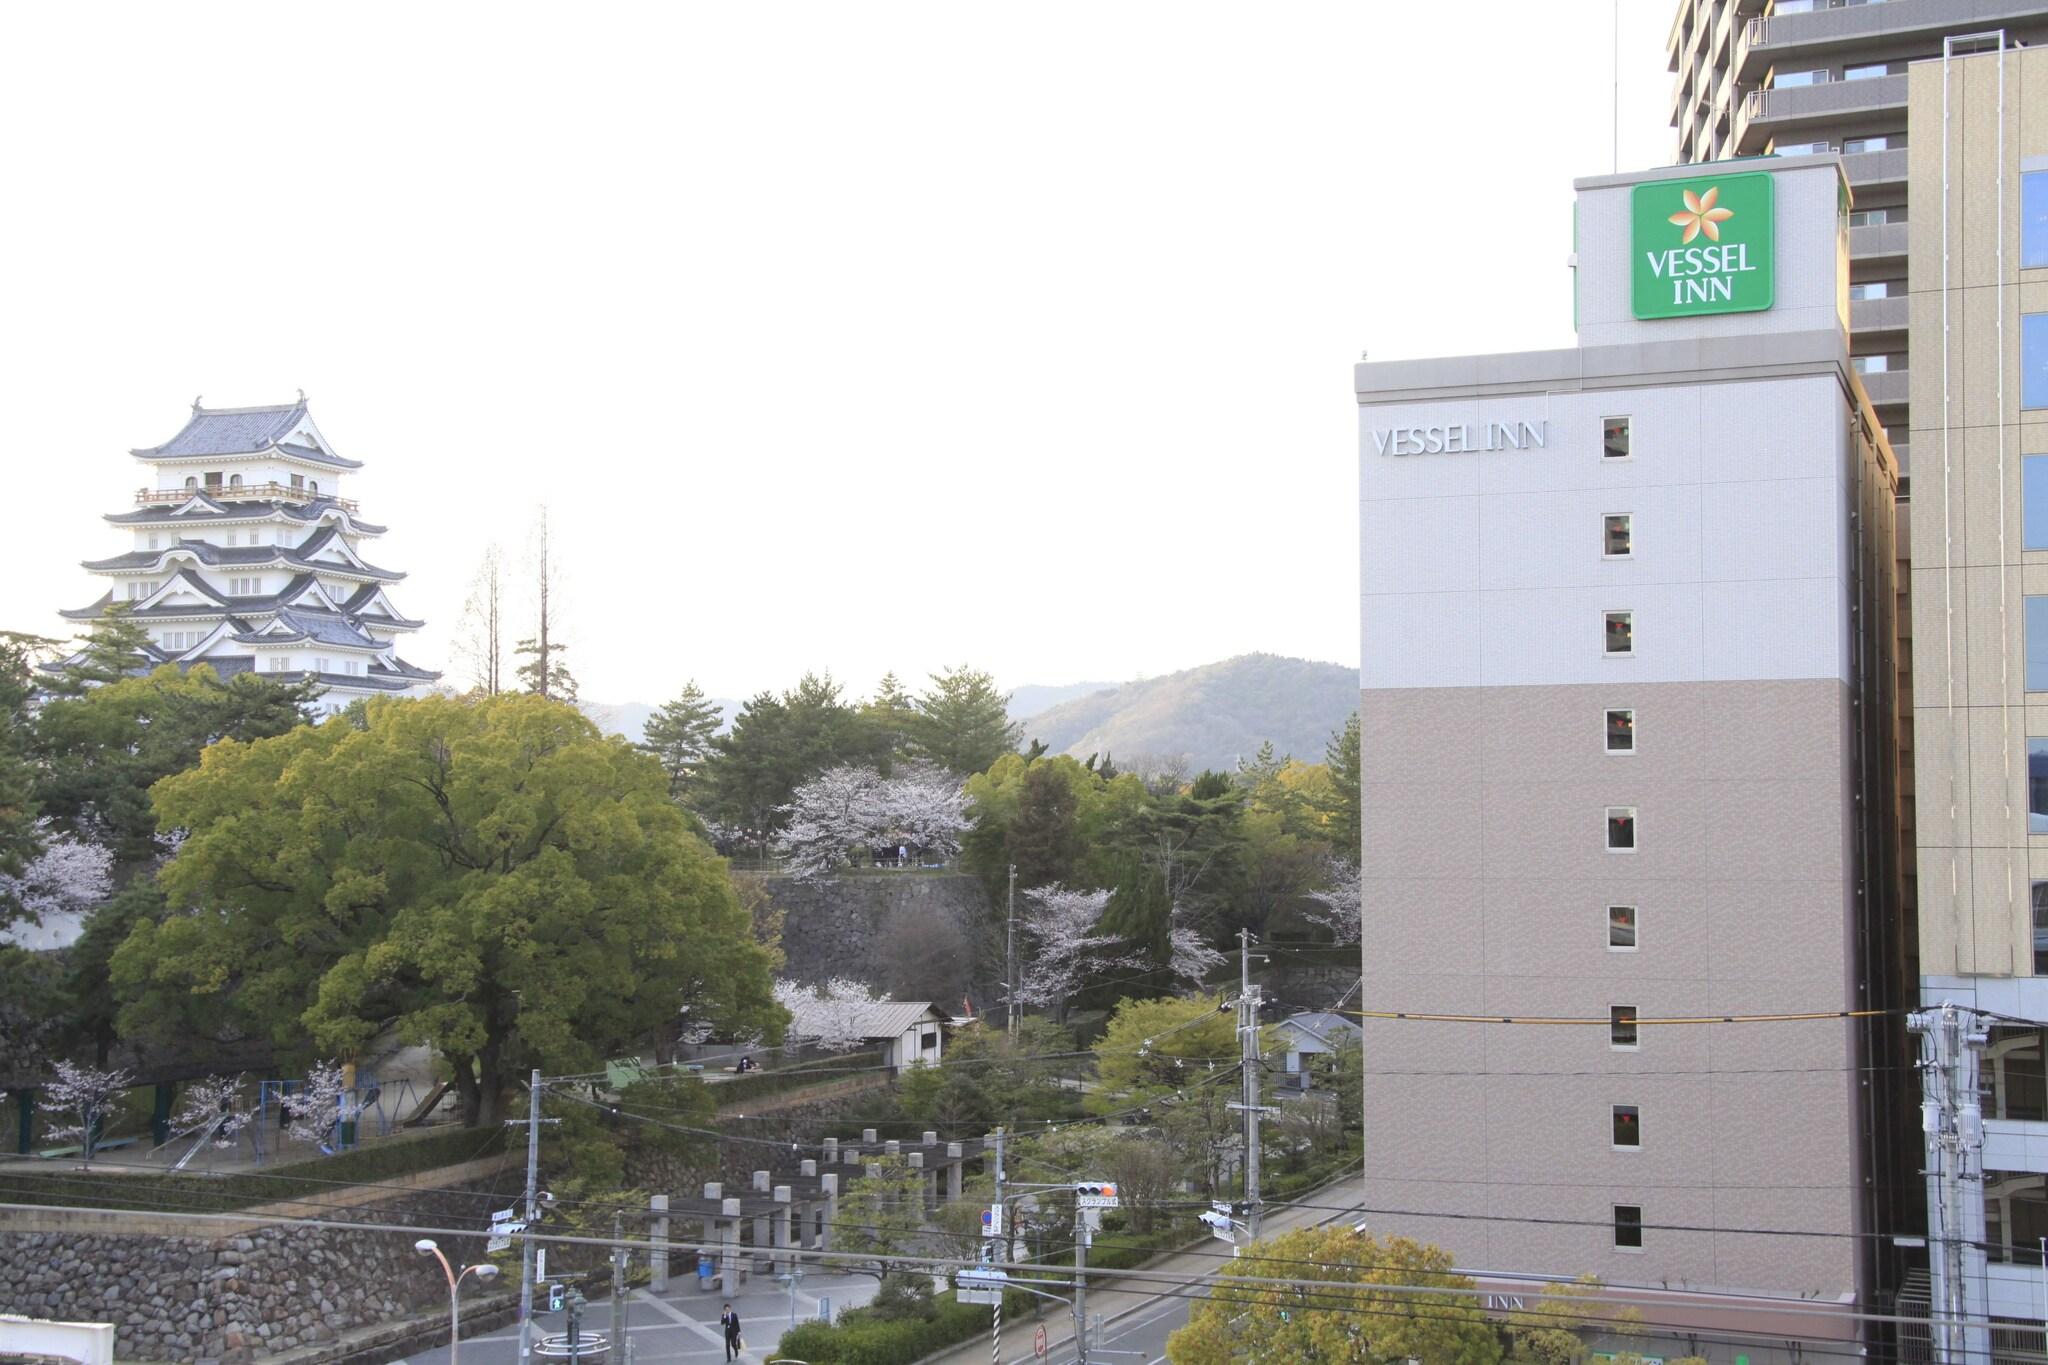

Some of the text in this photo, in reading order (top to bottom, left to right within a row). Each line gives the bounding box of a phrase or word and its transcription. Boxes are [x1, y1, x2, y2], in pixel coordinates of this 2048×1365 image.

[1647, 243, 1756, 278] VESSEL
[1673, 276, 1733, 305] INN
[1372, 421, 1548, 457] VESSEL INN
[1488, 1294, 1524, 1310] INN
